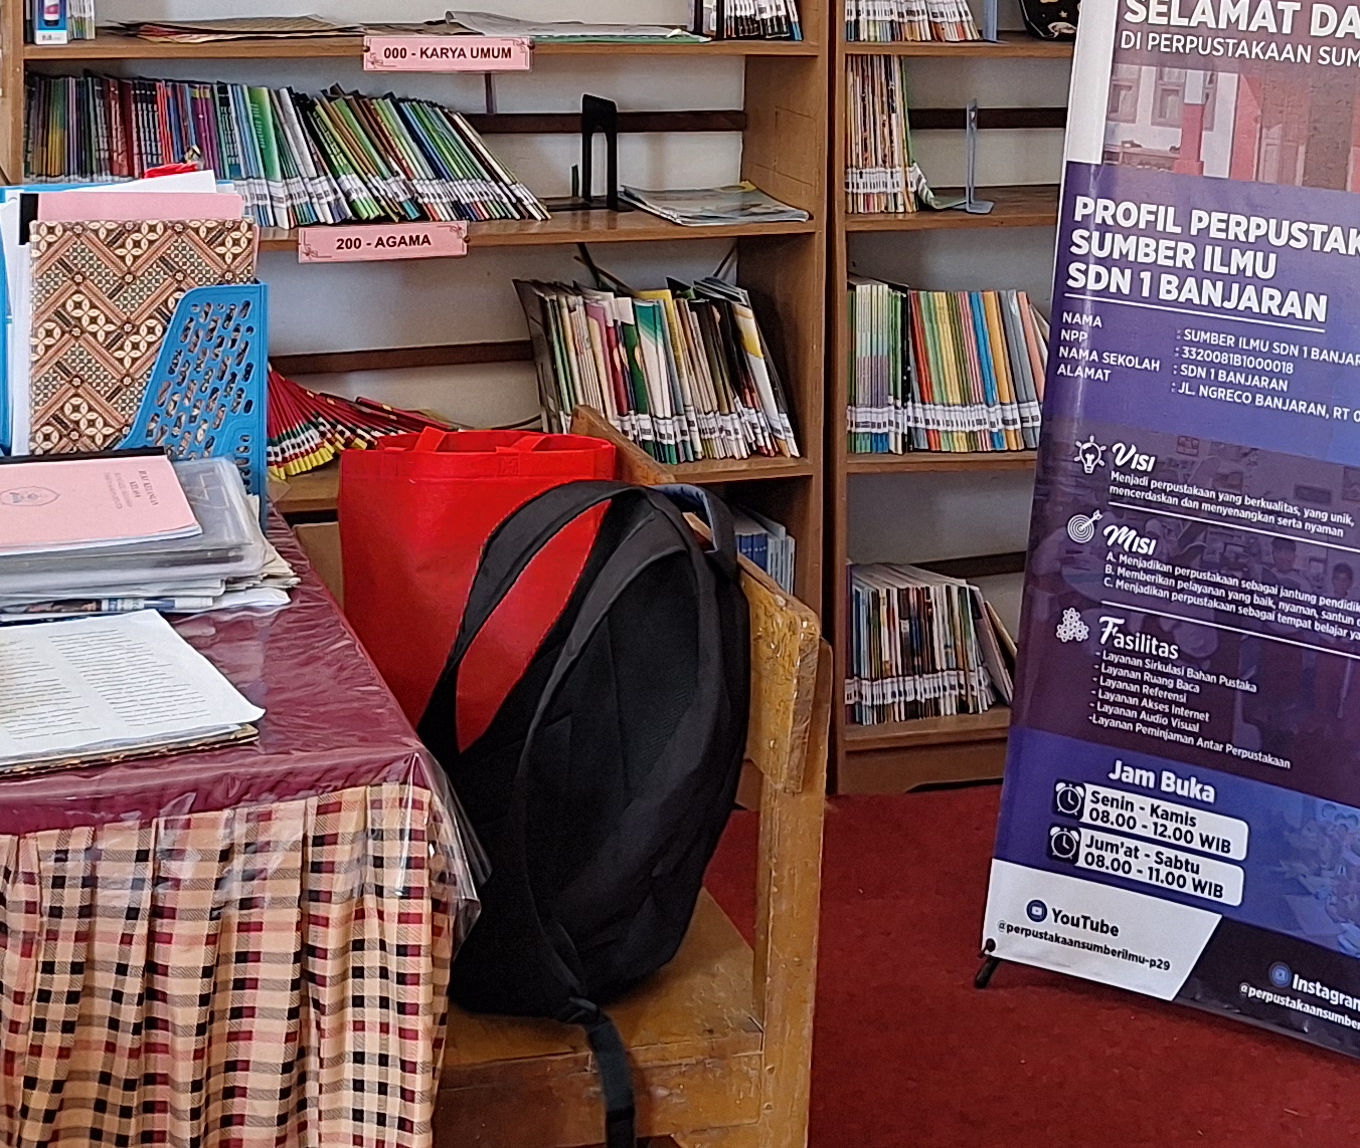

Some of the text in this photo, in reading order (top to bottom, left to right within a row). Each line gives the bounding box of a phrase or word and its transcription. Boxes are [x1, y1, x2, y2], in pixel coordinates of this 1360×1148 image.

[384, 47, 512, 59] 000 KARYA UMUM
[1120, 30, 1141, 50] DI
[1147, 33, 1312, 63] PERPUSTAKAAN
[1073, 195, 1182, 234] PROFIL
[336, 234, 431, 250] 200 AGAMA
[1069, 229, 1276, 279] SUMBER ILMU
[1065, 263, 1328, 322] SDN 1 BANJARAN
[1060, 329, 1294, 374] NPP 3320081B1000018
[1061, 312, 1103, 328] NAMA
[1183, 328, 1235, 348] SUMBER
[1238, 335, 1269, 351] ILMU
[1272, 340, 1299, 356] SDN
[1302, 345, 1308, 358] 1
[1059, 346, 1288, 392] NAMA SEKOLAH SDN 1 BANJARAN
[1056, 364, 1111, 382] ALAMAT
[1177, 381, 1196, 396] JL.
[1198, 385, 1252, 406] NGRECO
[1255, 392, 1330, 420] BANJARAN,
[1333, 406, 1350, 421] RT
[1098, 615, 1180, 660] Fasilitas
[1109, 759, 1216, 804] Jam Buka
[1088, 807, 1231, 854] 08.00 12.00 WIB
[1089, 789, 1197, 828] Senin Kamis
[1084, 834, 1201, 876] Jum'at Sabtu
[1084, 851, 1225, 900] 08.00 11.00 WIB
[1050, 907, 1120, 937] YouTube
